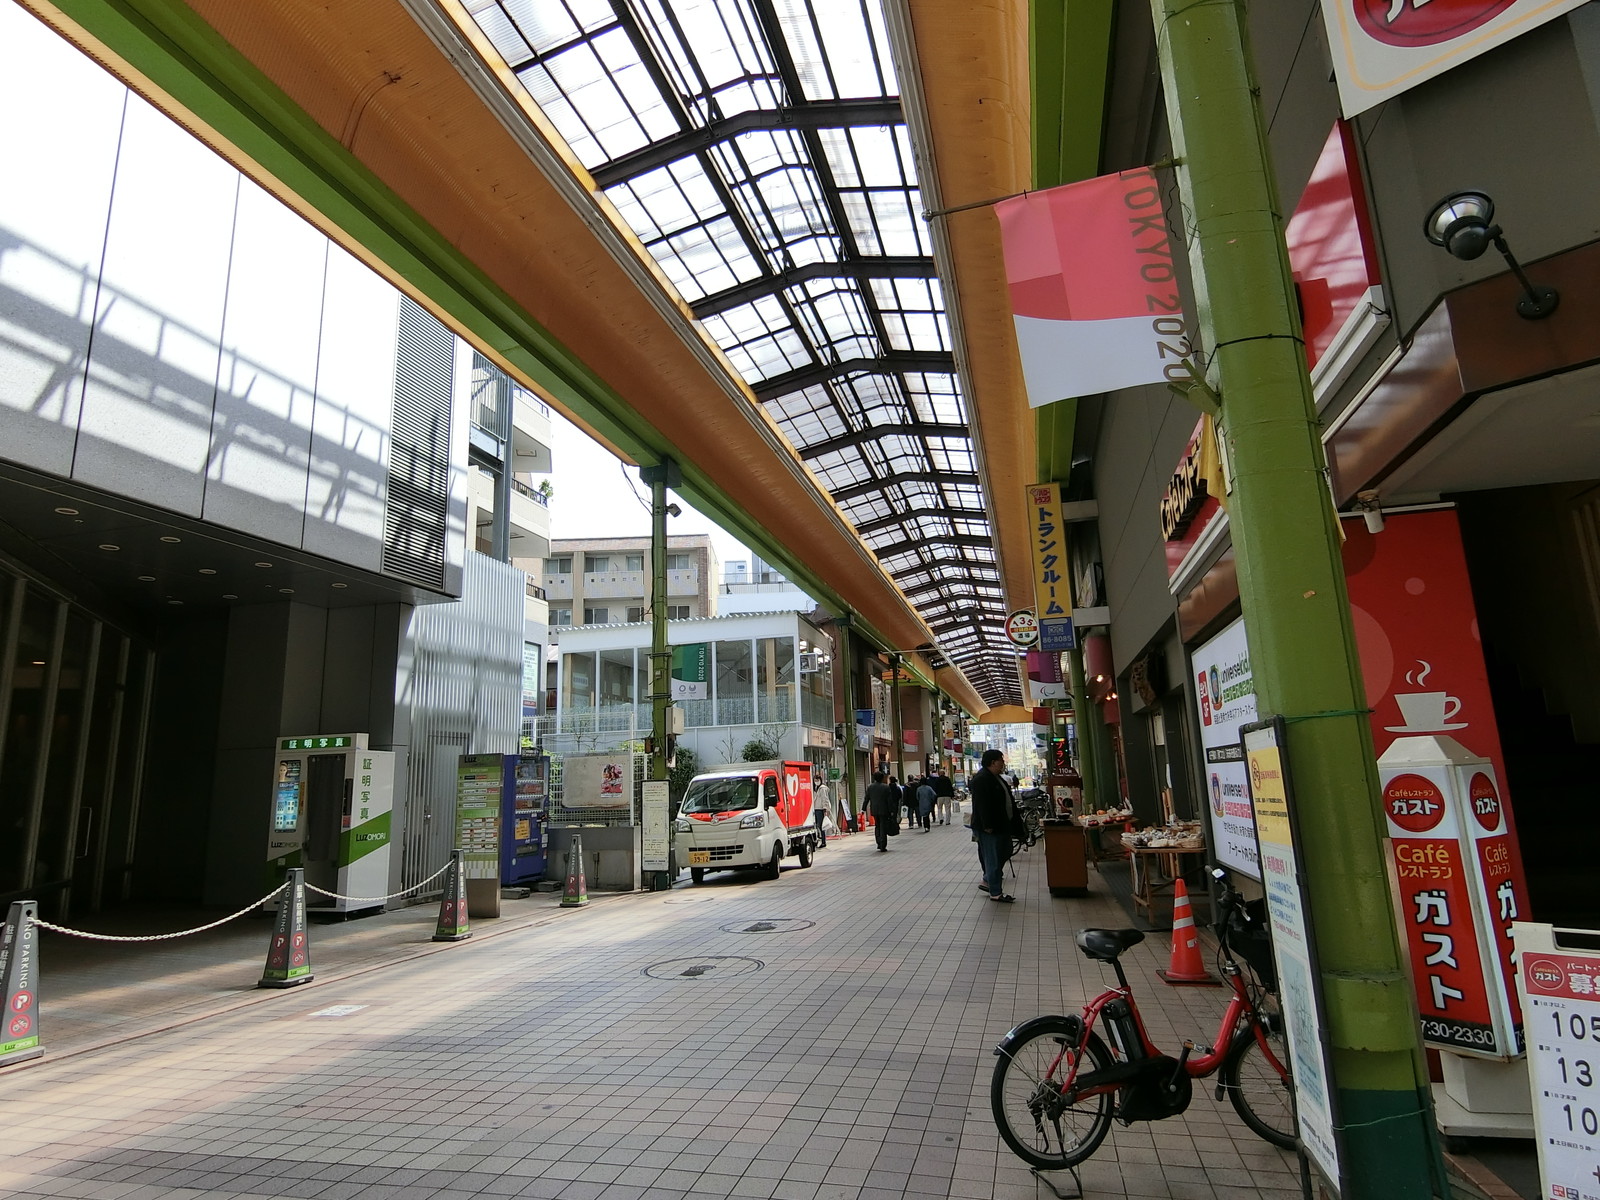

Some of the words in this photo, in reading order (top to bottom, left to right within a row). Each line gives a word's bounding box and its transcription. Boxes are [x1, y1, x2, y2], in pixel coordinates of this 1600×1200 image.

[1119, 166, 1175, 283] TOKYO
[1145, 293, 1194, 382] 2020
[1038, 507, 1064, 615] トランクルーム
[288, 737, 345, 749] 証明写真
[359, 758, 373, 820] 証明写真
[1388, 789, 1434, 797] Caféレストラン
[1392, 798, 1439, 815] ガスト
[1475, 797, 1498, 815] ガスト
[355, 833, 386, 842] LuzOMORI
[1396, 844, 1450, 864] Café
[1485, 843, 1508, 863] Café
[1399, 865, 1453, 879] レストラン
[1488, 862, 1511, 877] レストラン
[284, 885, 291, 898] NO
[279, 900, 289, 933] PARKING
[22, 923, 32, 940] NO
[1414, 890, 1463, 1009] ガスト
[19, 944, 32, 989] PARKING
[1566, 962, 1600, 973] パート・
[1535, 972, 1561, 982] ガスト
[1420, 1020, 1494, 1045] 7:30-23:30
[4, 1040, 33, 1051] LuzOMORI
[1557, 1056, 1593, 1087] 13
[1563, 1103, 1598, 1136] 10
